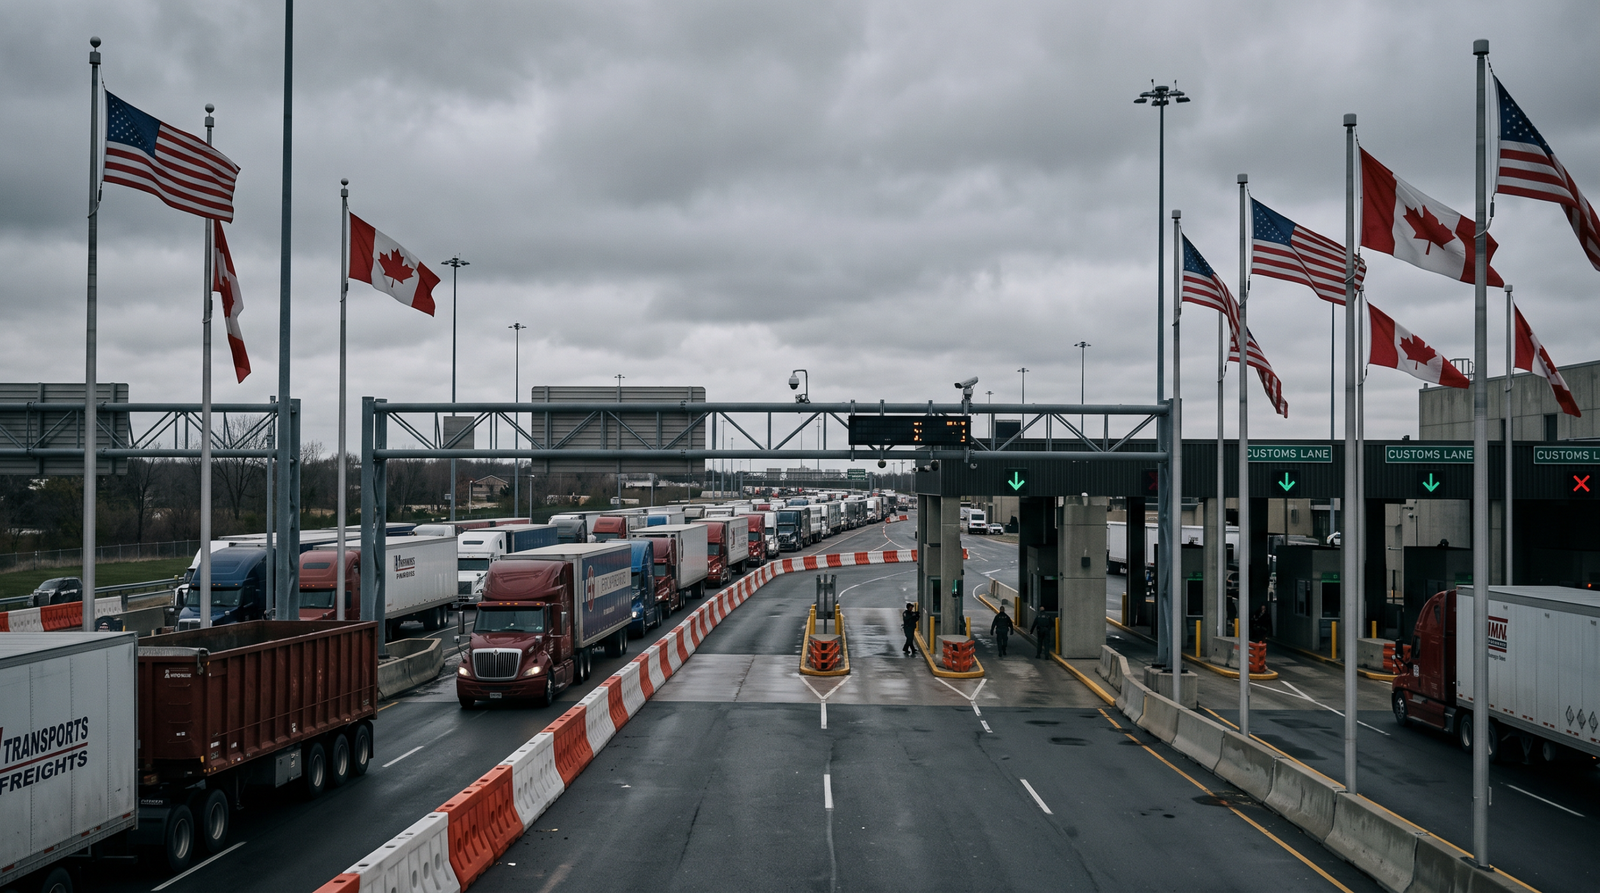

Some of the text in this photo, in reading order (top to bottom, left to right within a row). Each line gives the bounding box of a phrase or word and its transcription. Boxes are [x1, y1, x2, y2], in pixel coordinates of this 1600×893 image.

[1247, 448, 1329, 459] CUSTOMS LANE
[1388, 449, 1474, 459] CUSTOMS LANE
[1536, 450, 1590, 460] CUSTOMS
[3, 716, 89, 764] TRANSPORTS
[0, 750, 88, 796] FREIGHTS
